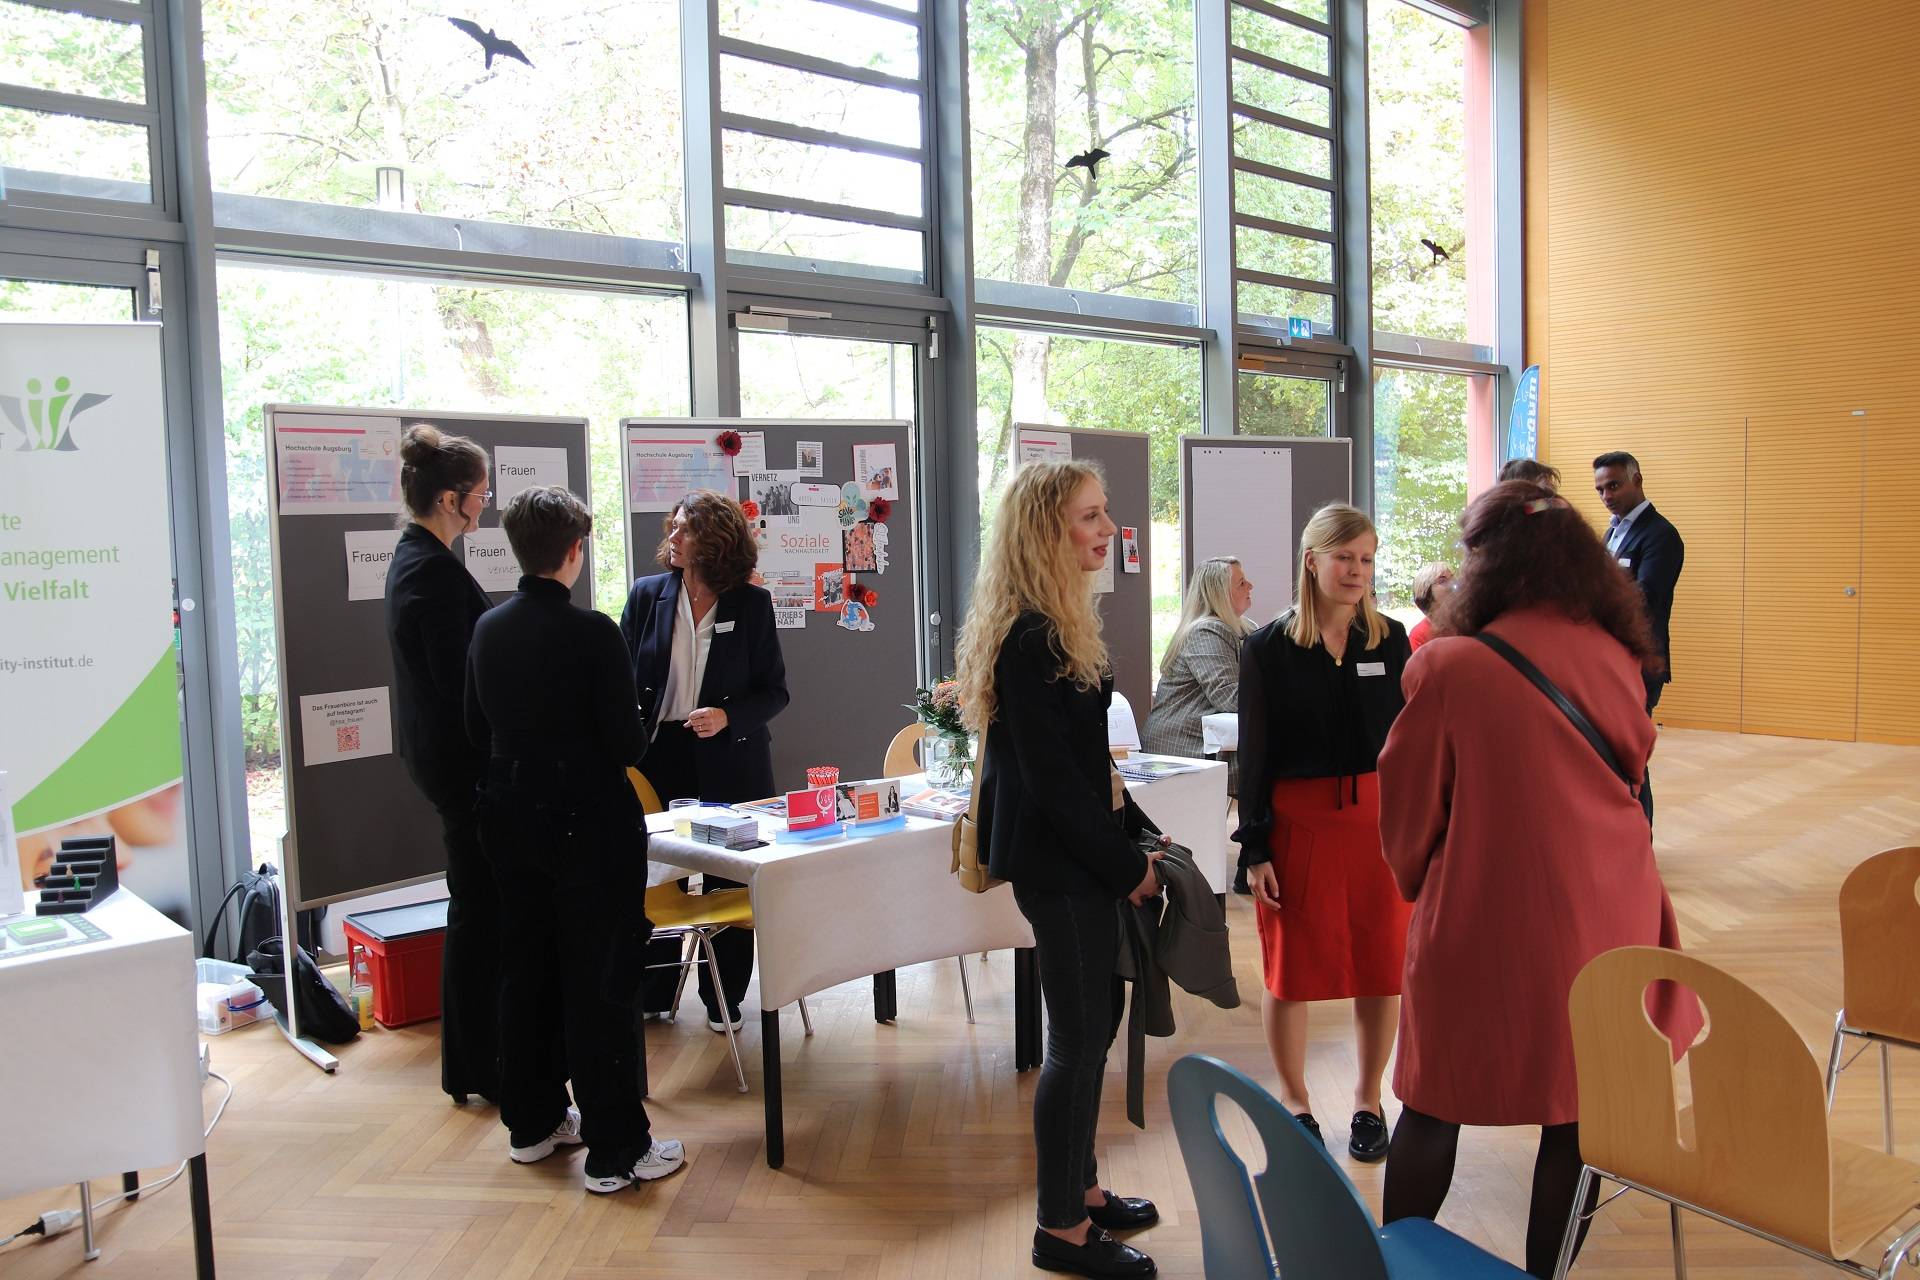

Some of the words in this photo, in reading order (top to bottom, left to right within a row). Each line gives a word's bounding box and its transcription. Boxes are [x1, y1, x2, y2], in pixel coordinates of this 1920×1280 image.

[322, 445, 352, 453] Augsburg
[499, 464, 536, 476] Frauen
[751, 473, 778, 482] VERNETZ
[780, 533, 830, 548] Soziale
[352, 550, 394, 563] Frauen
[469, 546, 506, 558] Frauen
[4, 579, 89, 600] Vielfalt
